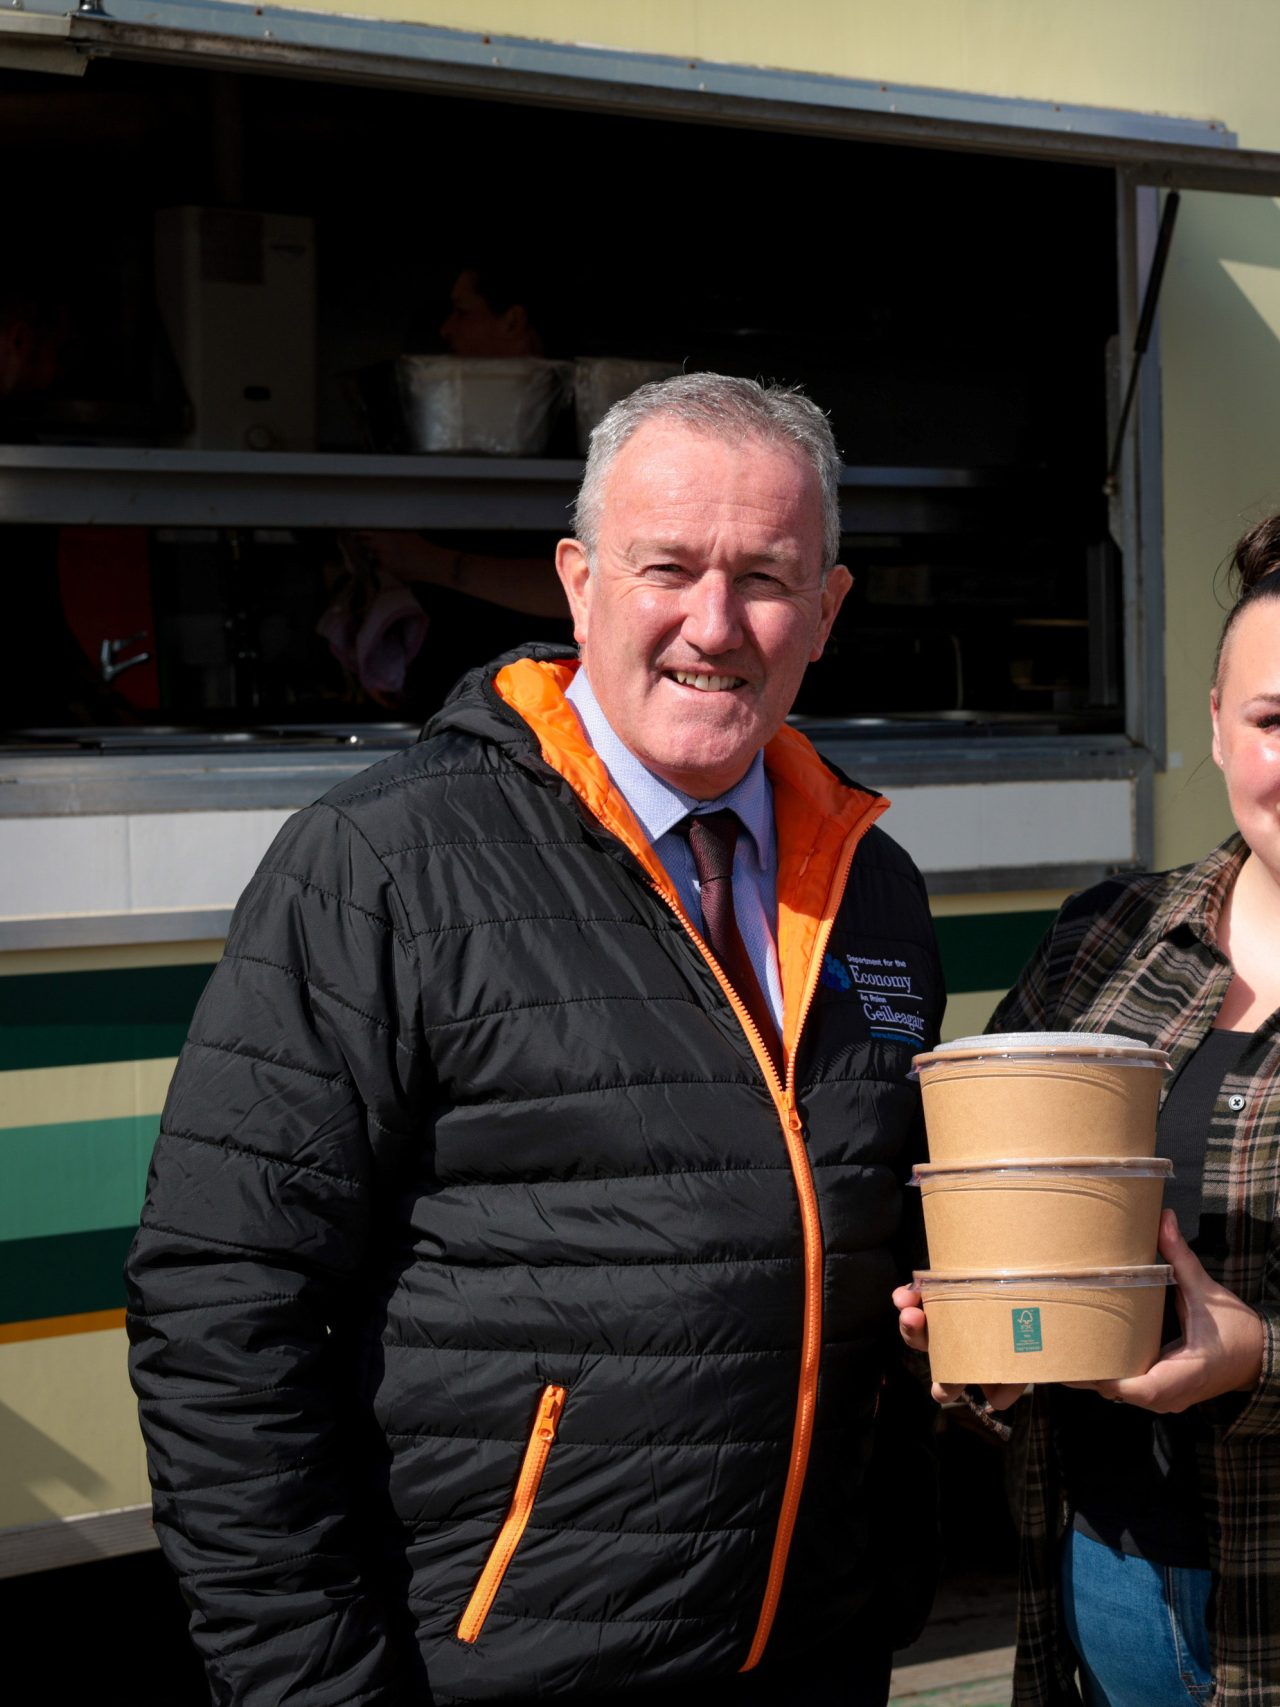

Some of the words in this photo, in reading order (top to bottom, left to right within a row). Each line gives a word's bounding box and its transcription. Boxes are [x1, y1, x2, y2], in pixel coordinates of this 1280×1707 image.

[846, 954, 883, 967] Department
[883, 958, 893, 967] for
[894, 959, 907, 968] the
[849, 965, 911, 993] Economy
[863, 1002, 925, 1031] Geilleagair
